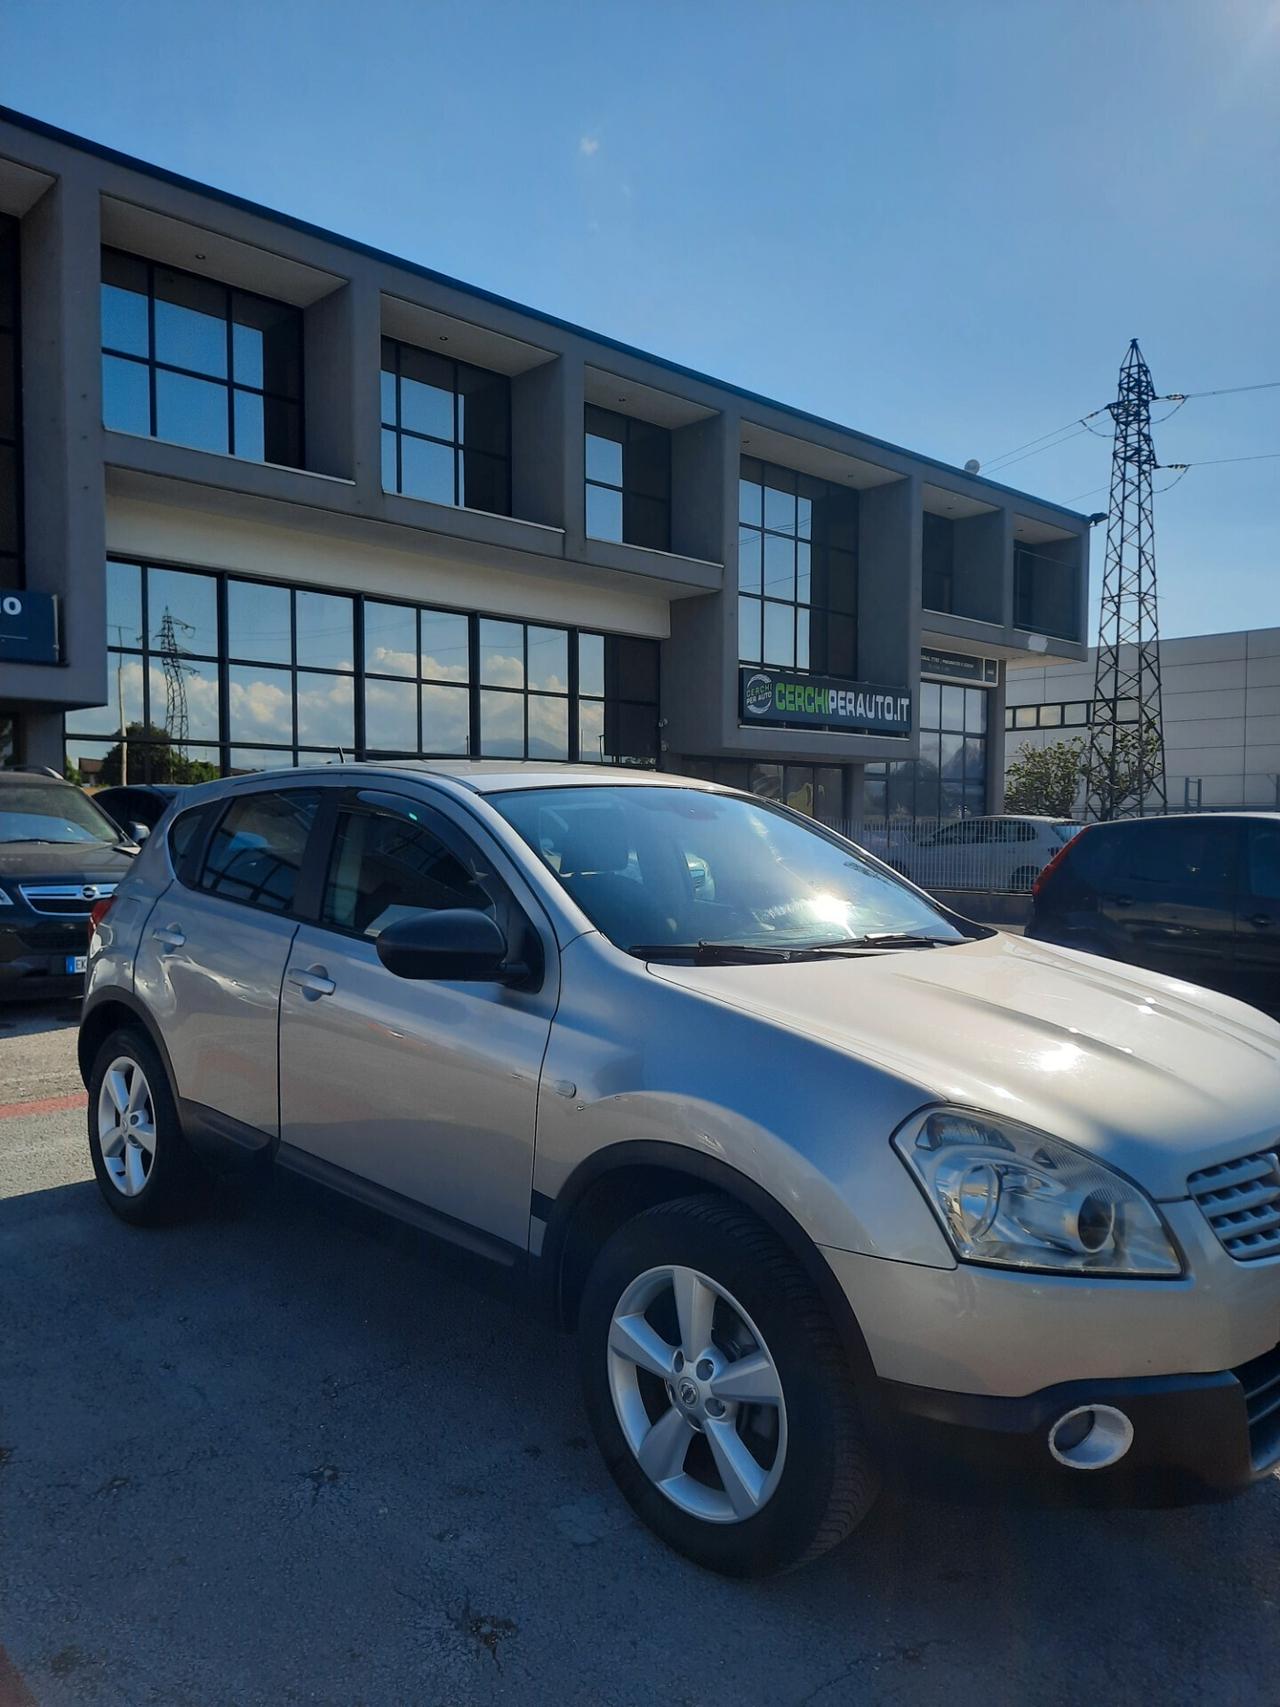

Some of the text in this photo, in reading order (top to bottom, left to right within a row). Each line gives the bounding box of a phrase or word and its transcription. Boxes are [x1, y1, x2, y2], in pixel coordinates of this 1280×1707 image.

[0, 597, 22, 615] O
[746, 683, 772, 698] CERCHI
[775, 682, 910, 721] CERCHIPERAUTO.IT
